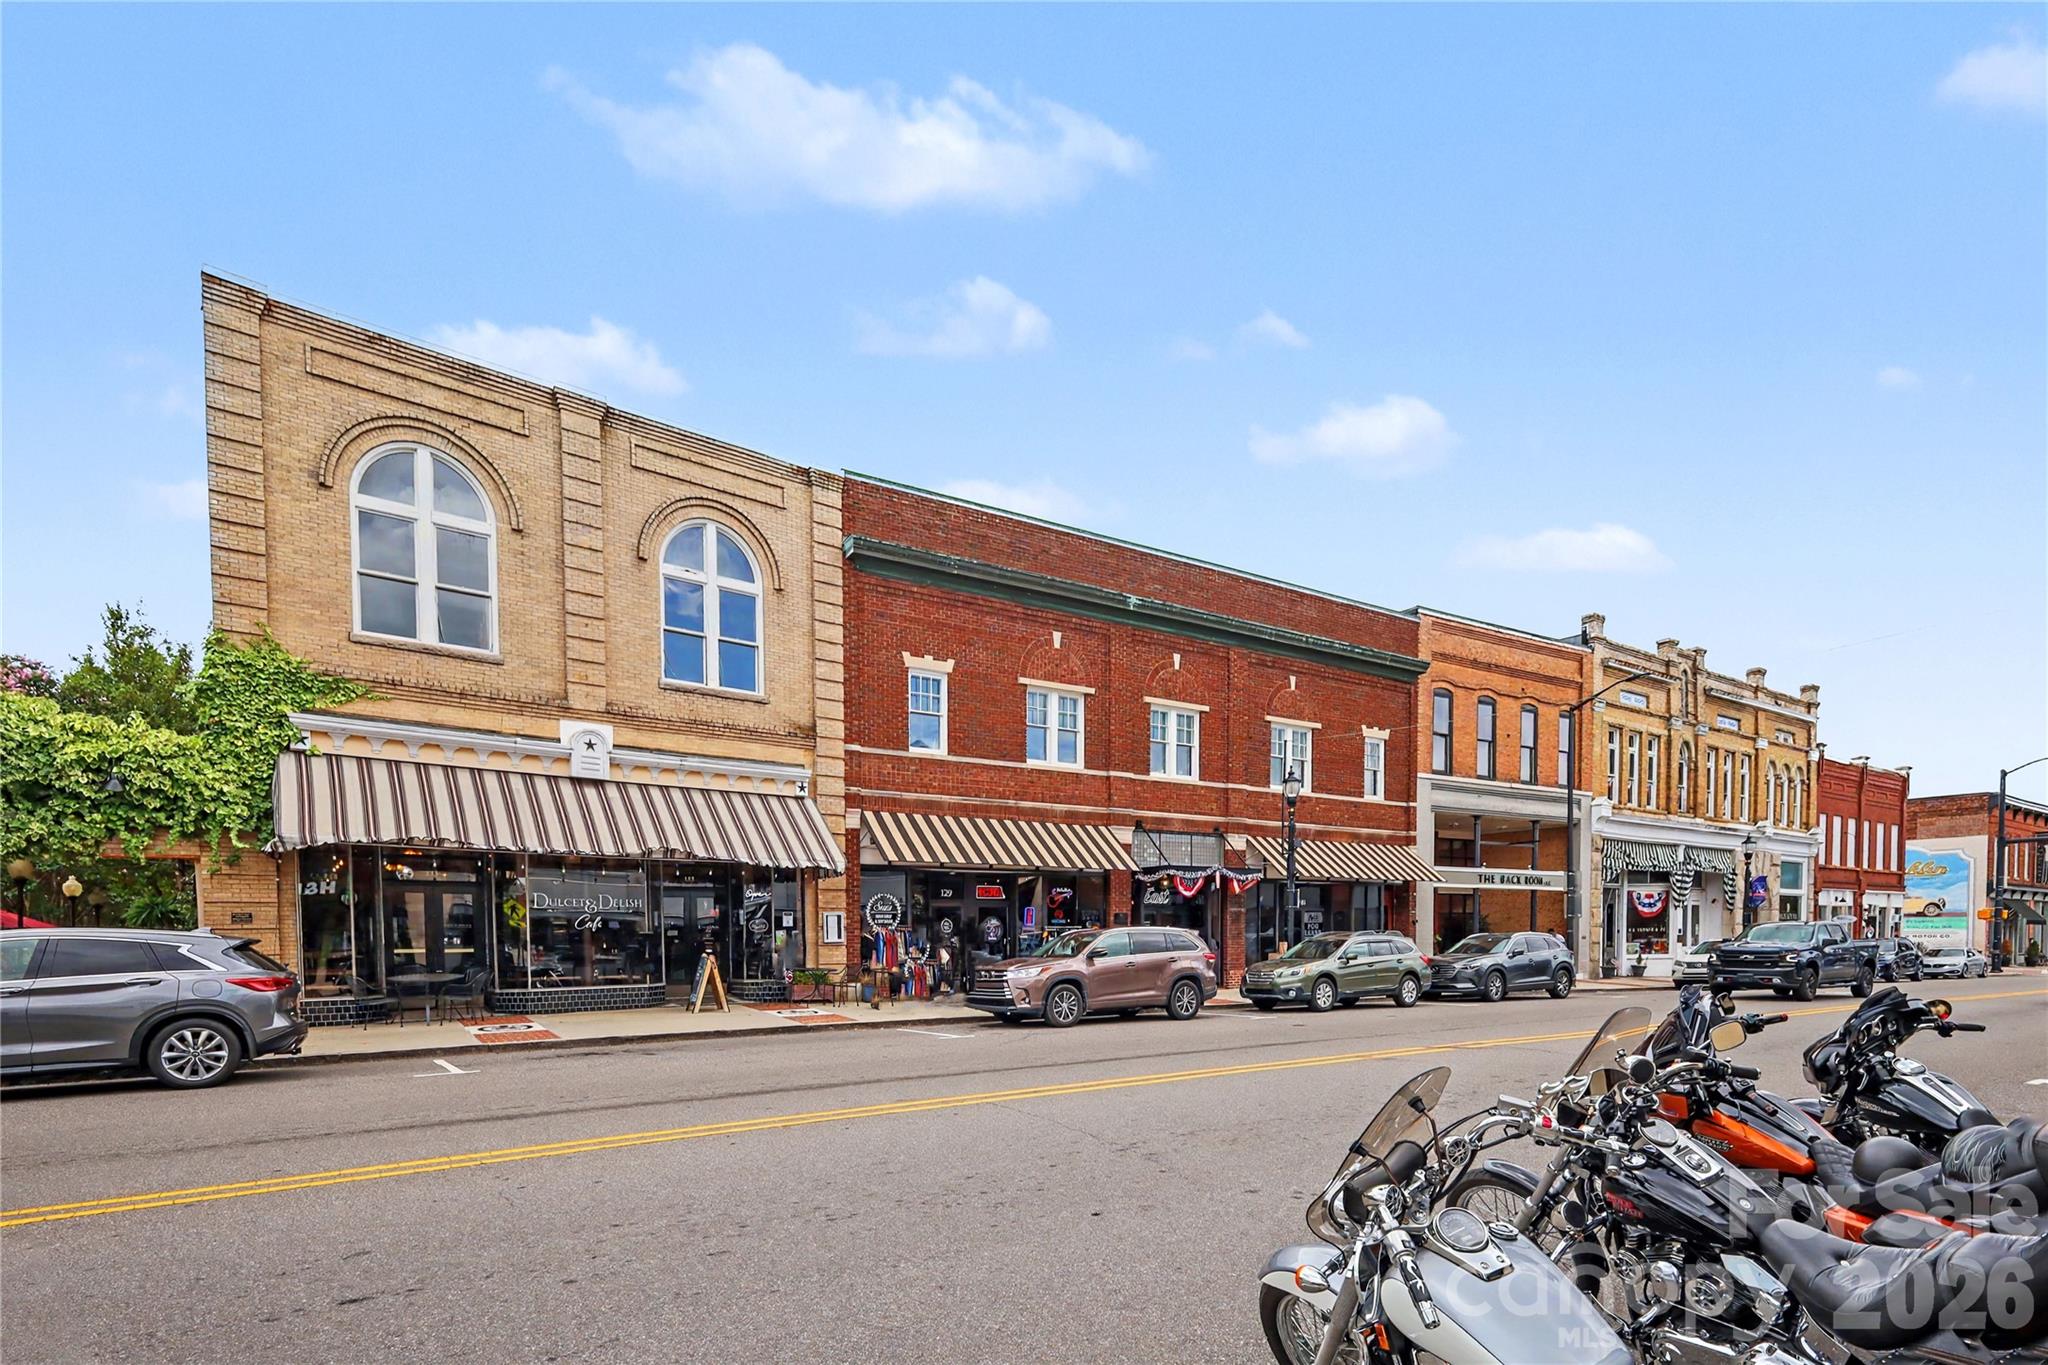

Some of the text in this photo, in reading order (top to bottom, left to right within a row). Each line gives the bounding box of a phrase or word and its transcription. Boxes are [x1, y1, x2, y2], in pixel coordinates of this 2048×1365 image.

[1478, 874, 1495, 884] THE
[1500, 875, 1521, 885] BACK
[1524, 876, 1543, 886] ROOM
[940, 888, 953, 898] 129
[532, 892, 643, 914] DULCET & DELISH
